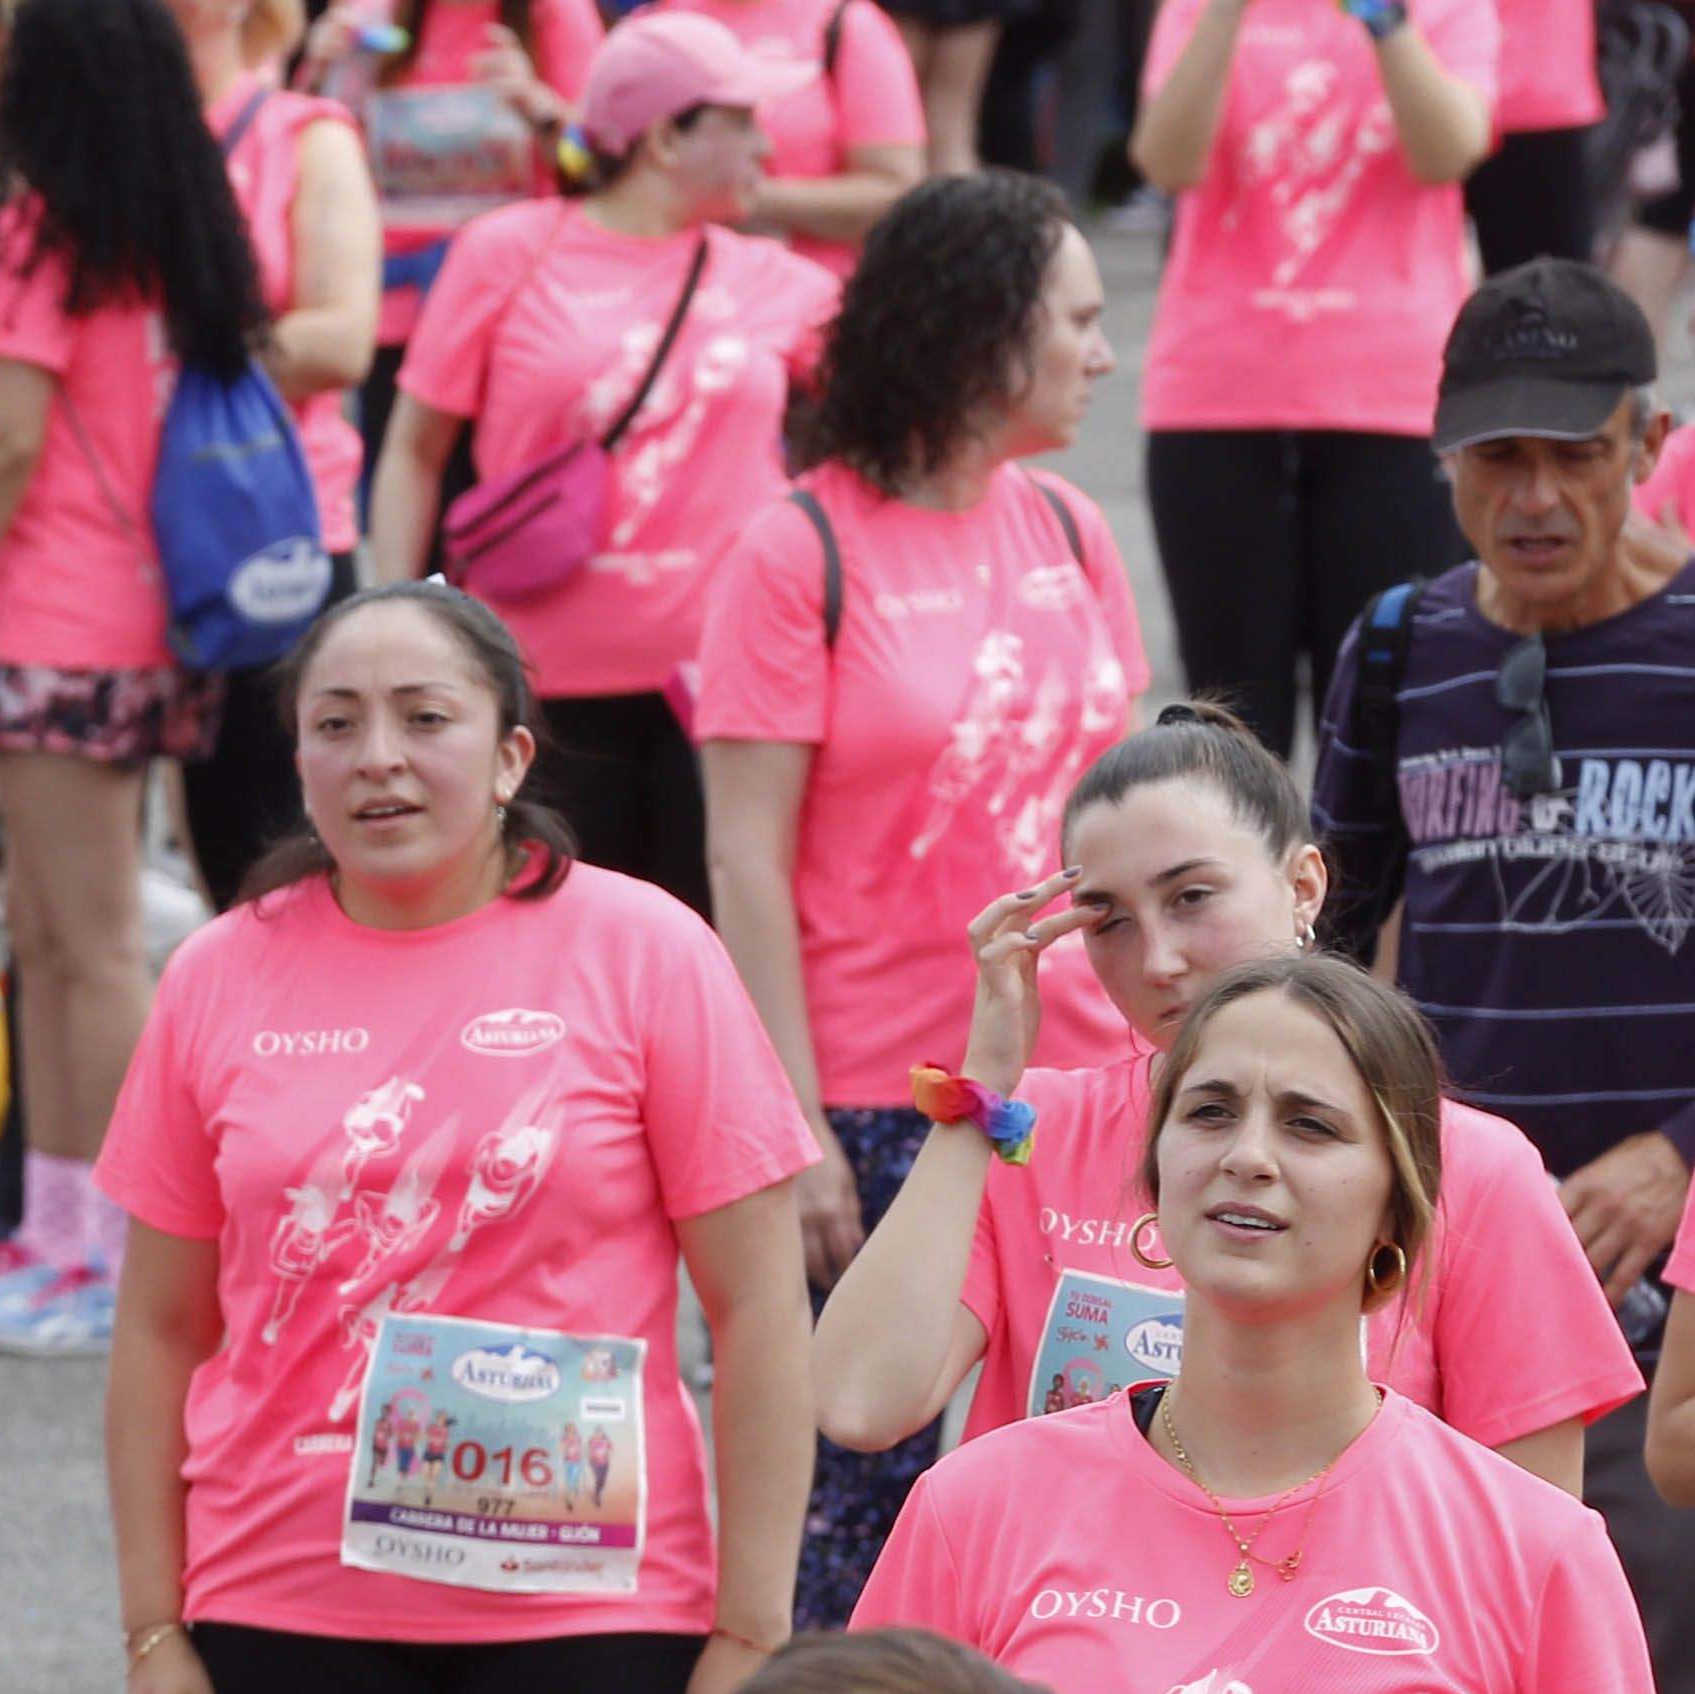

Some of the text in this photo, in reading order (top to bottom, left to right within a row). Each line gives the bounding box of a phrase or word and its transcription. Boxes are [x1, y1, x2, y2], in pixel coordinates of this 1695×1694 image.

[252, 1027, 370, 1057] OYSHO
[1065, 1302, 1109, 1325] SUMA
[451, 1440, 554, 1488] 016
[477, 1494, 516, 1515] 977
[374, 1533, 466, 1567] OYSHO
[1030, 1588, 1181, 1629] OYSHO
